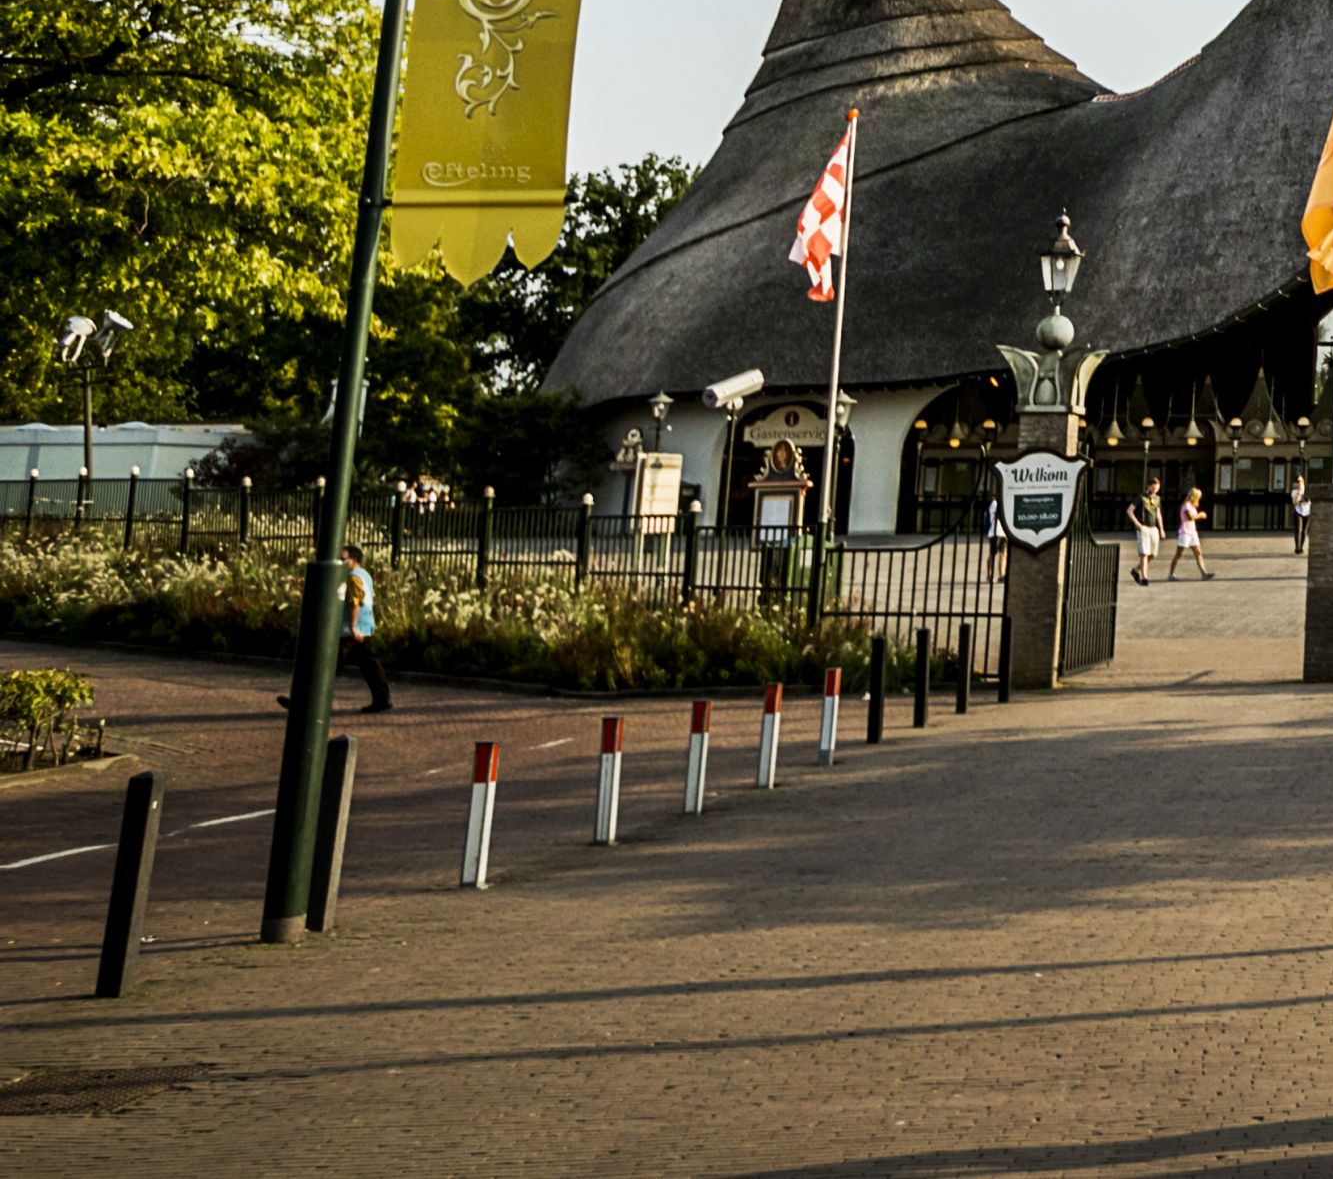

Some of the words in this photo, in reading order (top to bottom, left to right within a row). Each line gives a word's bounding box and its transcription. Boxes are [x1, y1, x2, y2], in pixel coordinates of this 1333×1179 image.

[421, 161, 532, 187] efteling
[750, 426, 827, 441] Gastenservic
[1011, 467, 1068, 483] Welkom
